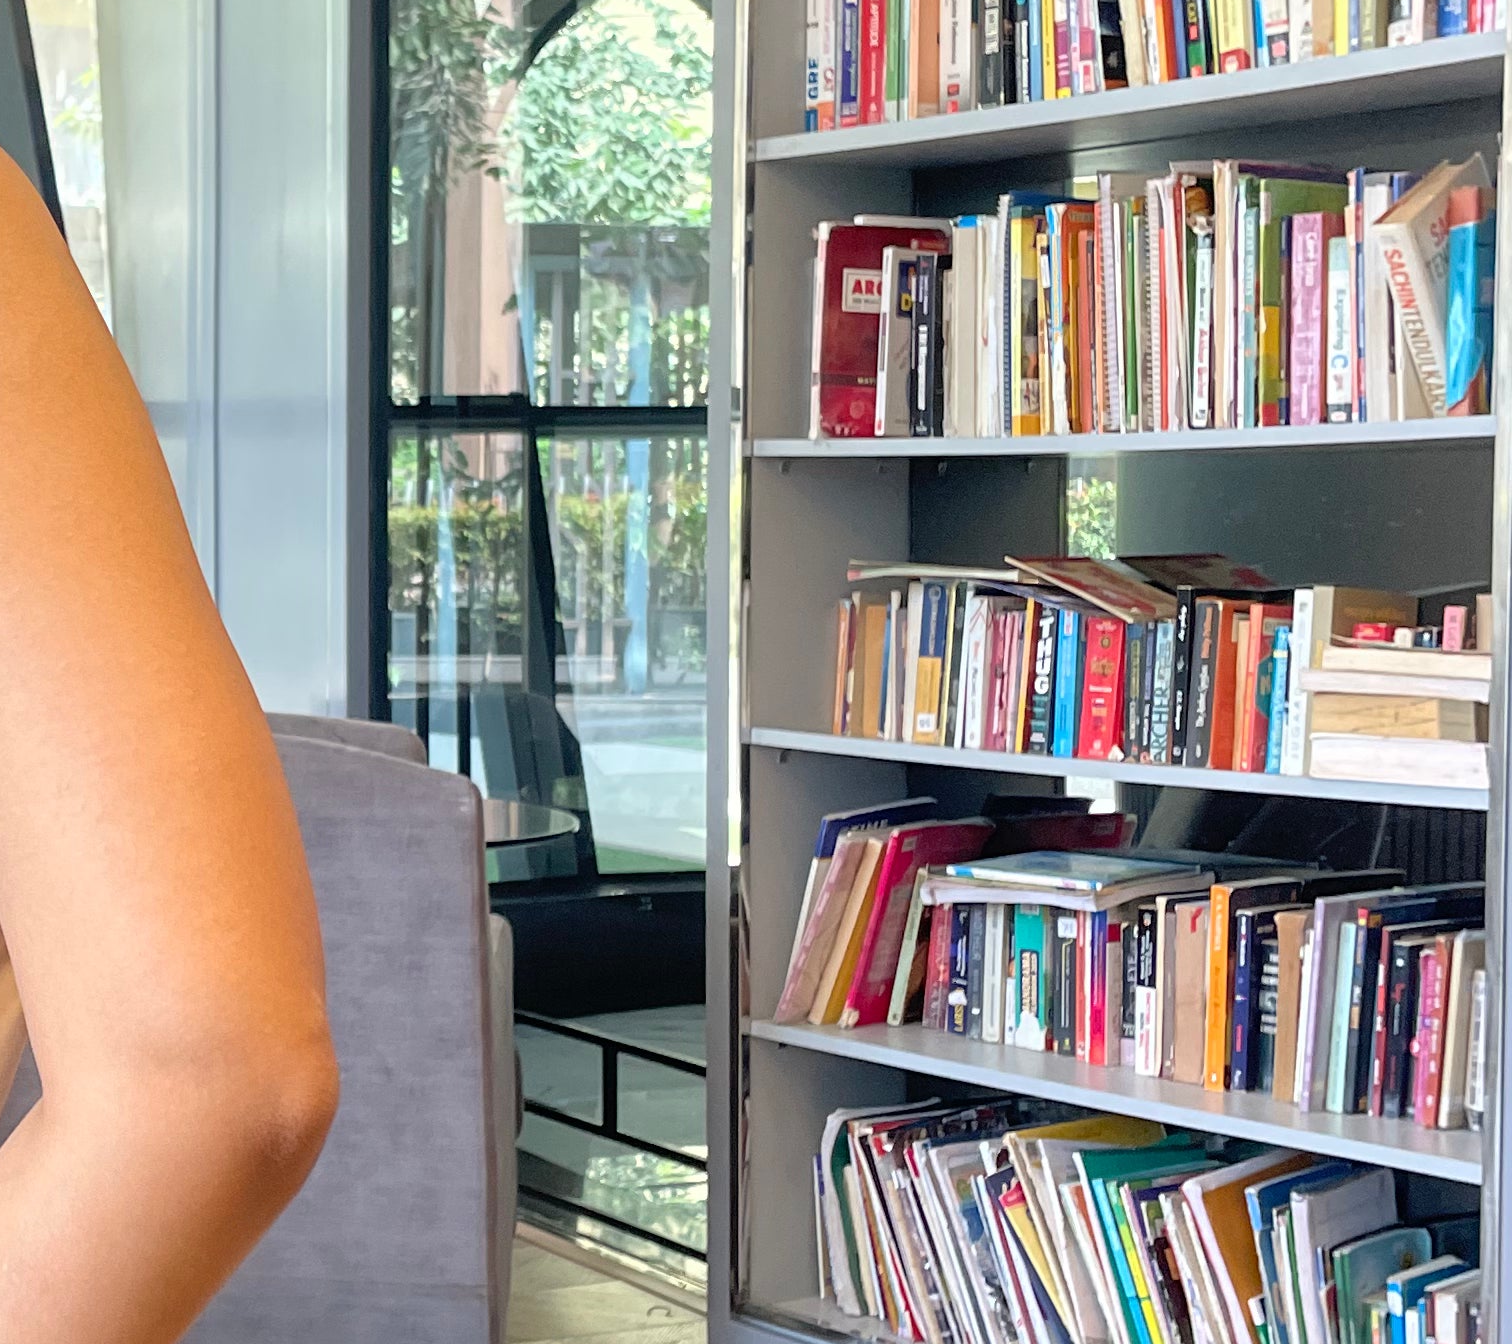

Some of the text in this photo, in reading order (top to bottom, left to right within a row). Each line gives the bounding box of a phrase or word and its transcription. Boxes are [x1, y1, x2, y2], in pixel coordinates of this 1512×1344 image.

[808, 57, 819, 100] GRE
[1331, 354, 1349, 369] C
[1034, 615, 1055, 695] THUG
